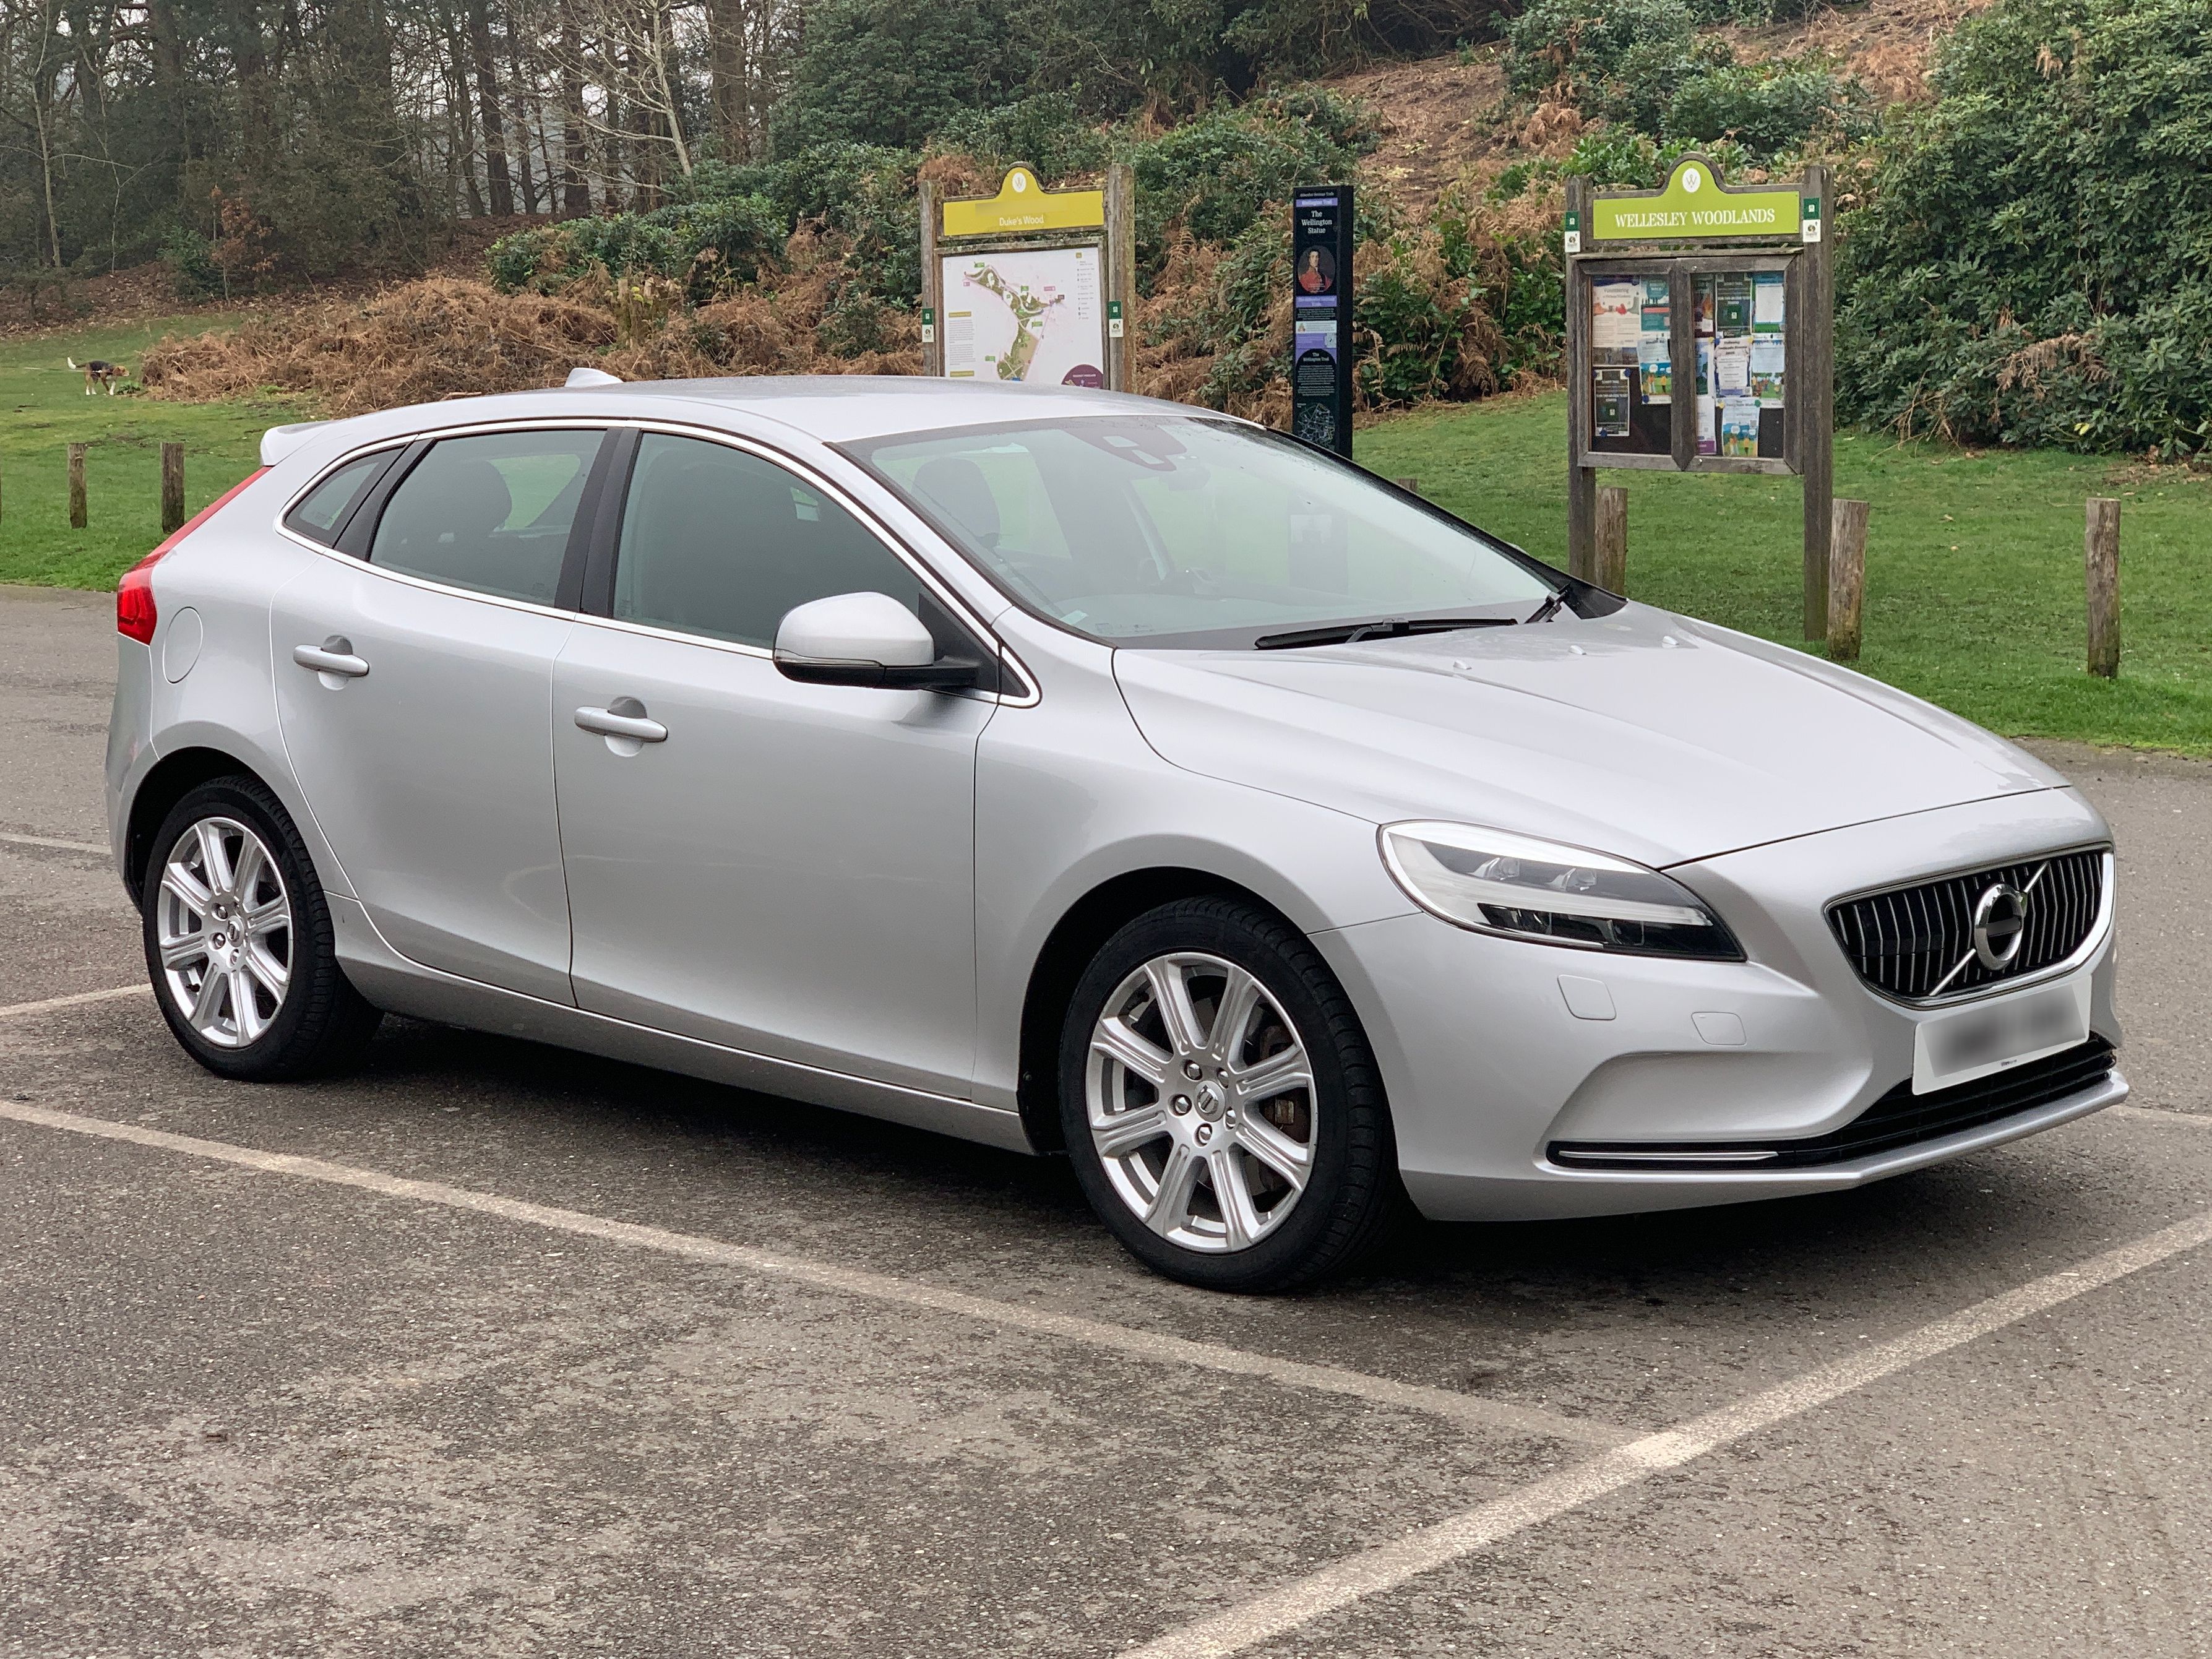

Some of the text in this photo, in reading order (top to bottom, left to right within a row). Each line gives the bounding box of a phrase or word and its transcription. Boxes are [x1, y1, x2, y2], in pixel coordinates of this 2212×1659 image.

[999, 214, 1044, 226] Duke's Wood
[1301, 218, 1332, 226] Wellington
[1615, 209, 1775, 228] WELLESLEY WOODLANDS
